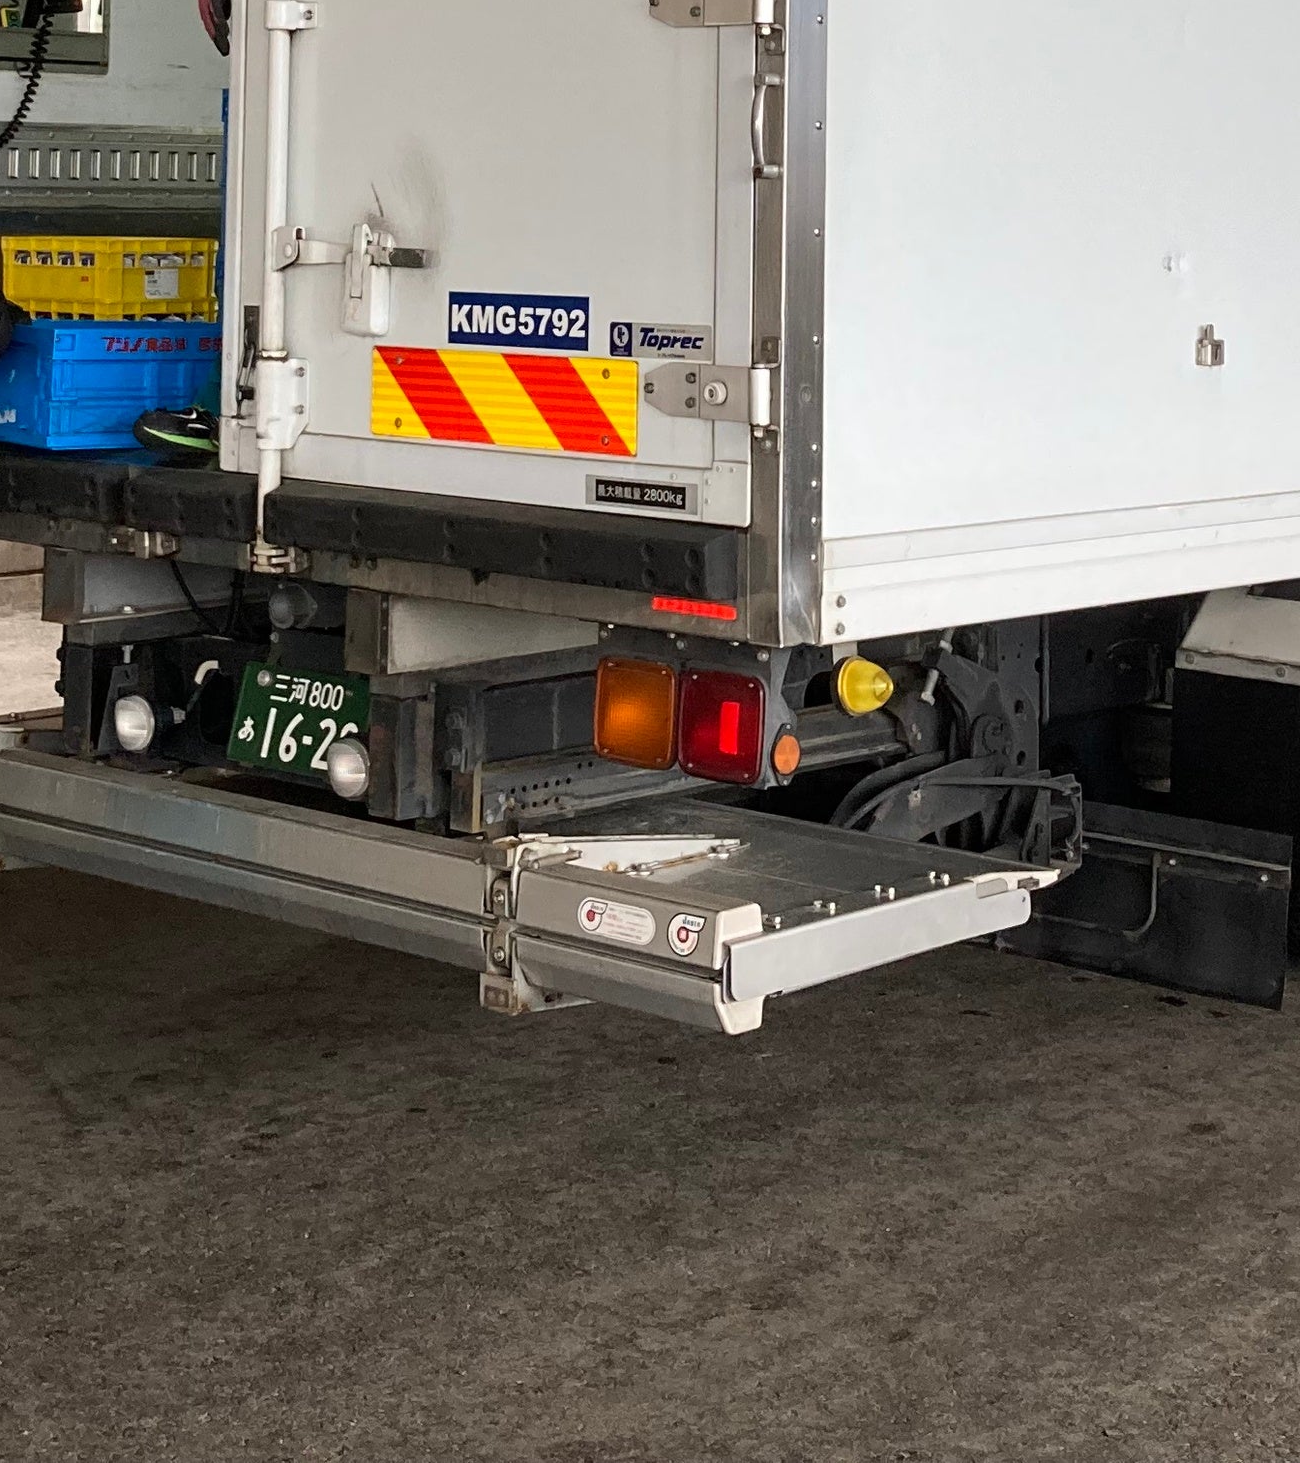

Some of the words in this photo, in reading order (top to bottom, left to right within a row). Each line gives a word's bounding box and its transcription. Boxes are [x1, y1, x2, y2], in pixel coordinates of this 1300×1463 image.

[451, 303, 586, 339] KMG5792
[640, 327, 704, 350] Toprec
[643, 488, 683, 506] 2800kg
[238, 716, 255, 742] あ
